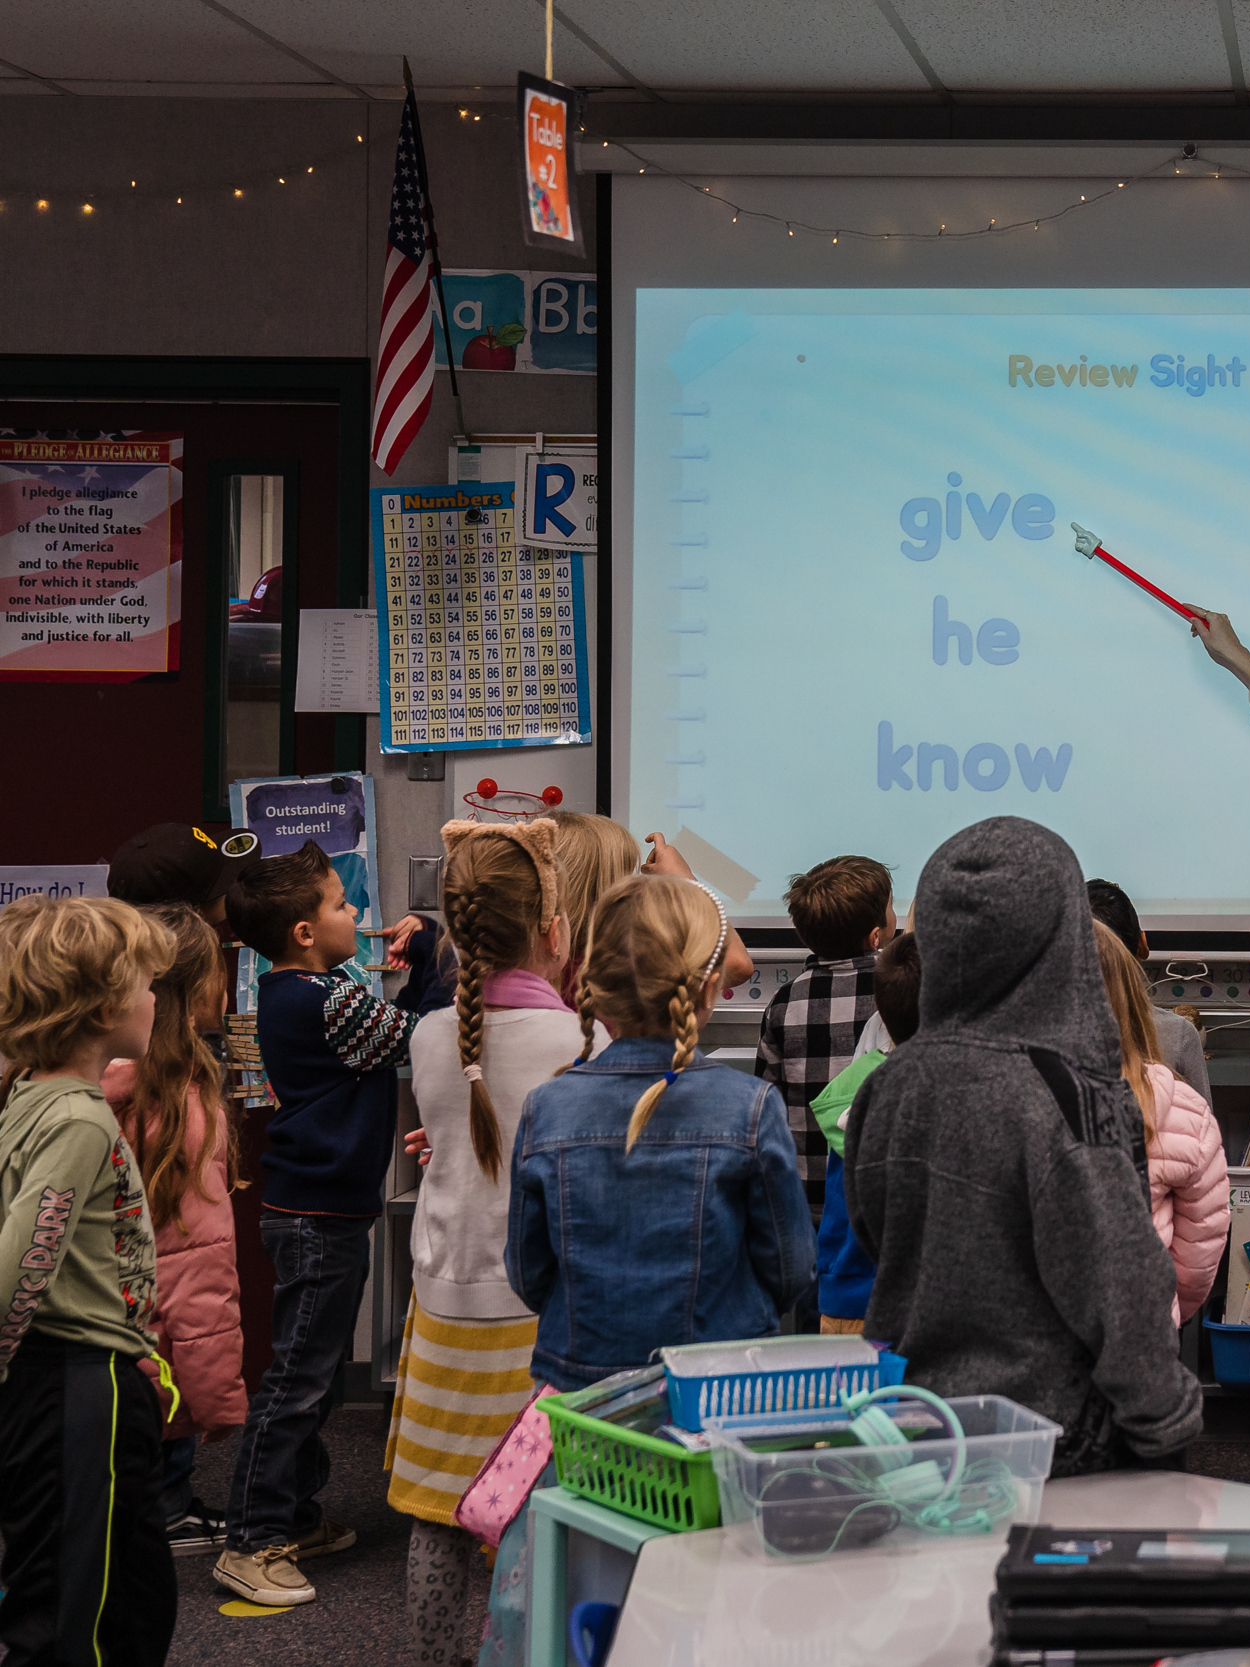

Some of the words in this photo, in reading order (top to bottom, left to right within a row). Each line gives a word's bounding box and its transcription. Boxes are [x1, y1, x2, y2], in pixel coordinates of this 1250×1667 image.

[529, 112, 563, 151] Table
[538, 154, 558, 190] #2
[1008, 355, 1138, 388] Review
[1150, 354, 1246, 397] Sight
[13, 442, 68, 460] PLEDGE
[74, 443, 161, 461] ALLEGIANCE
[22, 486, 26, 497] I
[29, 486, 72, 501] pledge
[75, 487, 138, 501] allegiance
[388, 499, 395, 510] 0
[403, 491, 502, 510] Numbers
[533, 463, 577, 538] R
[46, 505, 60, 516] to
[64, 504, 85, 516] the
[88, 505, 113, 519] flag
[900, 471, 1056, 562] give
[17, 522, 31, 533] of
[35, 522, 56, 534] the
[58, 522, 99, 534] United
[102, 523, 142, 535] States
[44, 540, 59, 551] of
[62, 541, 114, 552] America
[18, 558, 41, 569] and
[44, 559, 58, 570] to
[61, 558, 83, 570] the
[86, 559, 140, 573] Republic
[18, 576, 38, 587] for
[42, 576, 78, 588] which
[82, 577, 92, 588] it
[95, 577, 139, 590] stands,
[8, 596, 31, 605] one
[34, 594, 76, 606] Nation
[79, 595, 116, 606] under
[119, 595, 148, 608] God,
[391, 595, 402, 607] 41
[409, 594, 422, 606] 42
[428, 593, 441, 605] 43
[446, 592, 459, 604] 44
[465, 592, 478, 603] 45
[483, 590, 496, 602] 46
[502, 589, 514, 601] 47
[520, 588, 533, 600] 48
[538, 587, 551, 599] 49
[557, 586, 570, 598] 50
[5, 611, 72, 625] indivisible,
[76, 612, 104, 624] with
[108, 612, 150, 627] liberty
[21, 630, 44, 641] and
[47, 631, 89, 645] justice
[92, 630, 111, 642] for
[115, 631, 134, 643] all.
[932, 594, 1021, 666] he
[877, 720, 1073, 793] know
[265, 802, 347, 818] Outstanding
[275, 820, 331, 836] student!
[48, 882, 72, 900] do
[776, 968, 789, 984] 13
[1222, 968, 1243, 984] 30
[19, 1186, 76, 1270] PARK
